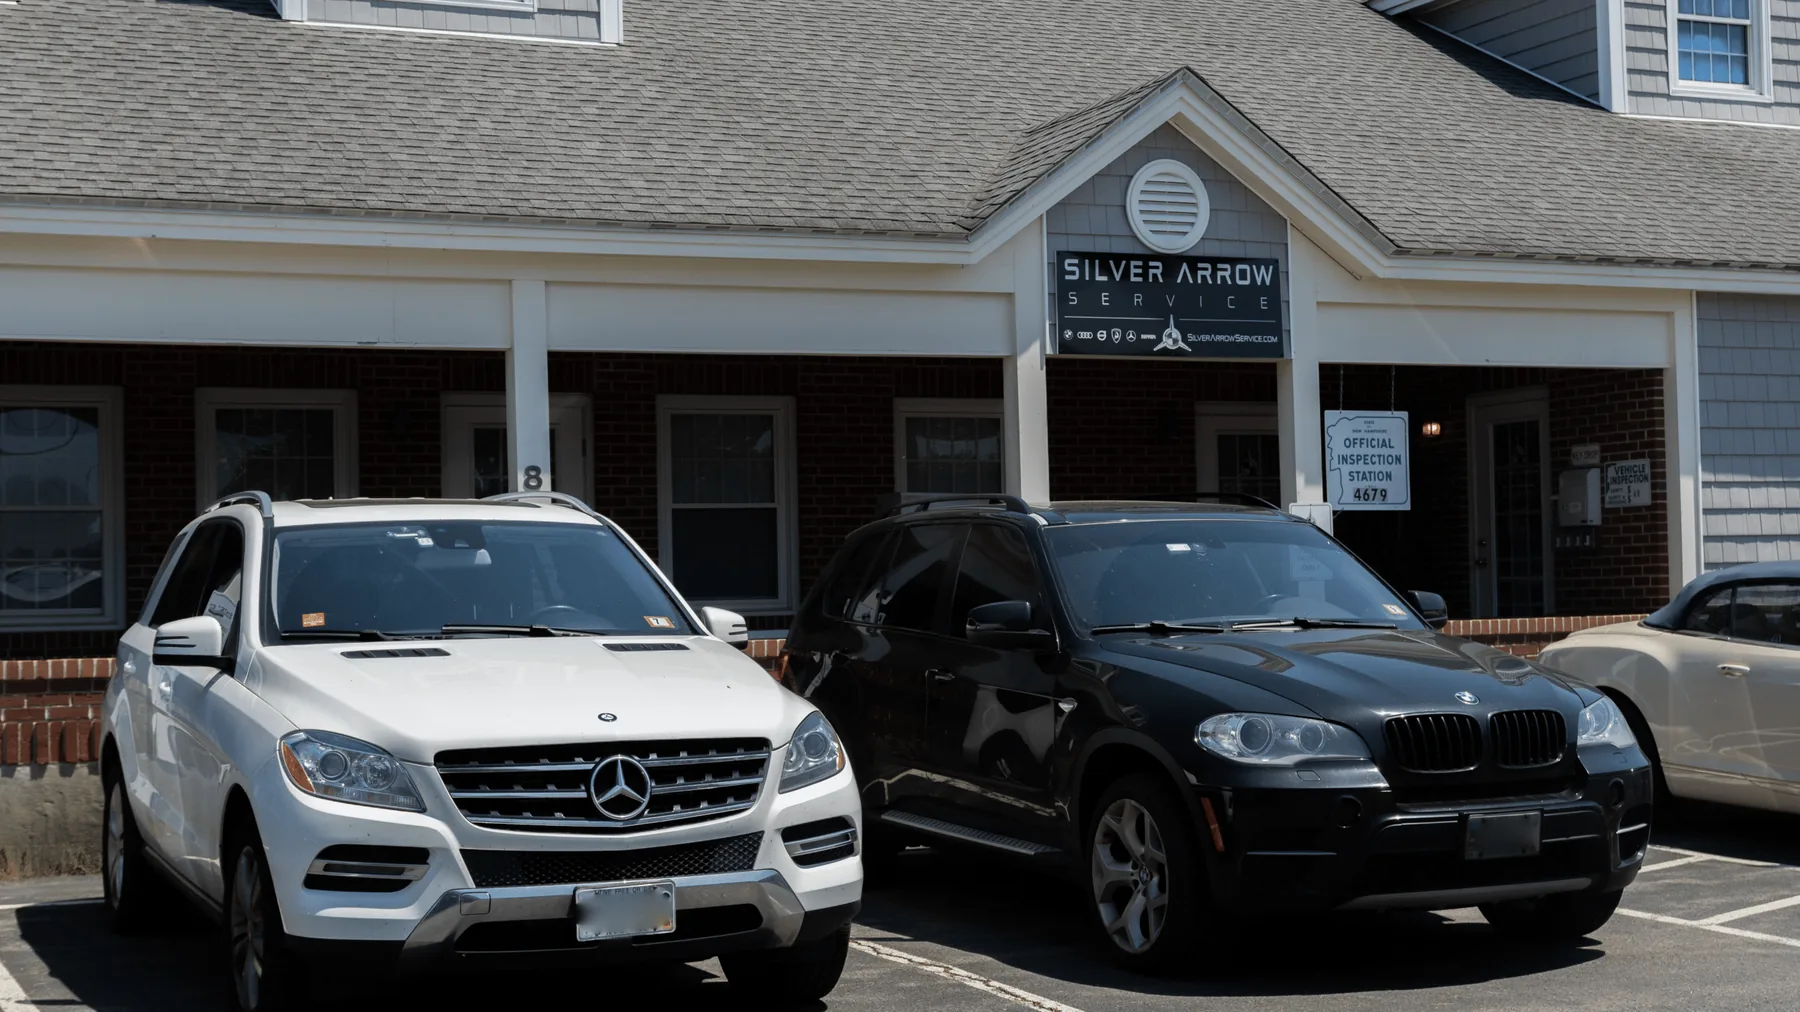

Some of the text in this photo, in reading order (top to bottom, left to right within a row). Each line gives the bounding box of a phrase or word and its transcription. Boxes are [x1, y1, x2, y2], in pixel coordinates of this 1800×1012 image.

[1064, 258, 1273, 286] SILVER ARROW
[1068, 291, 1268, 310] SERVICE
[1343, 437, 1395, 449] OFFICIAL
[1337, 454, 1402, 465] INSPECTION
[1614, 463, 1646, 475] VEHICLE
[523, 465, 543, 490] 8
[1348, 471, 1392, 482] STATION
[1610, 473, 1649, 485] INSPECTION
[1353, 488, 1388, 502] 4679
